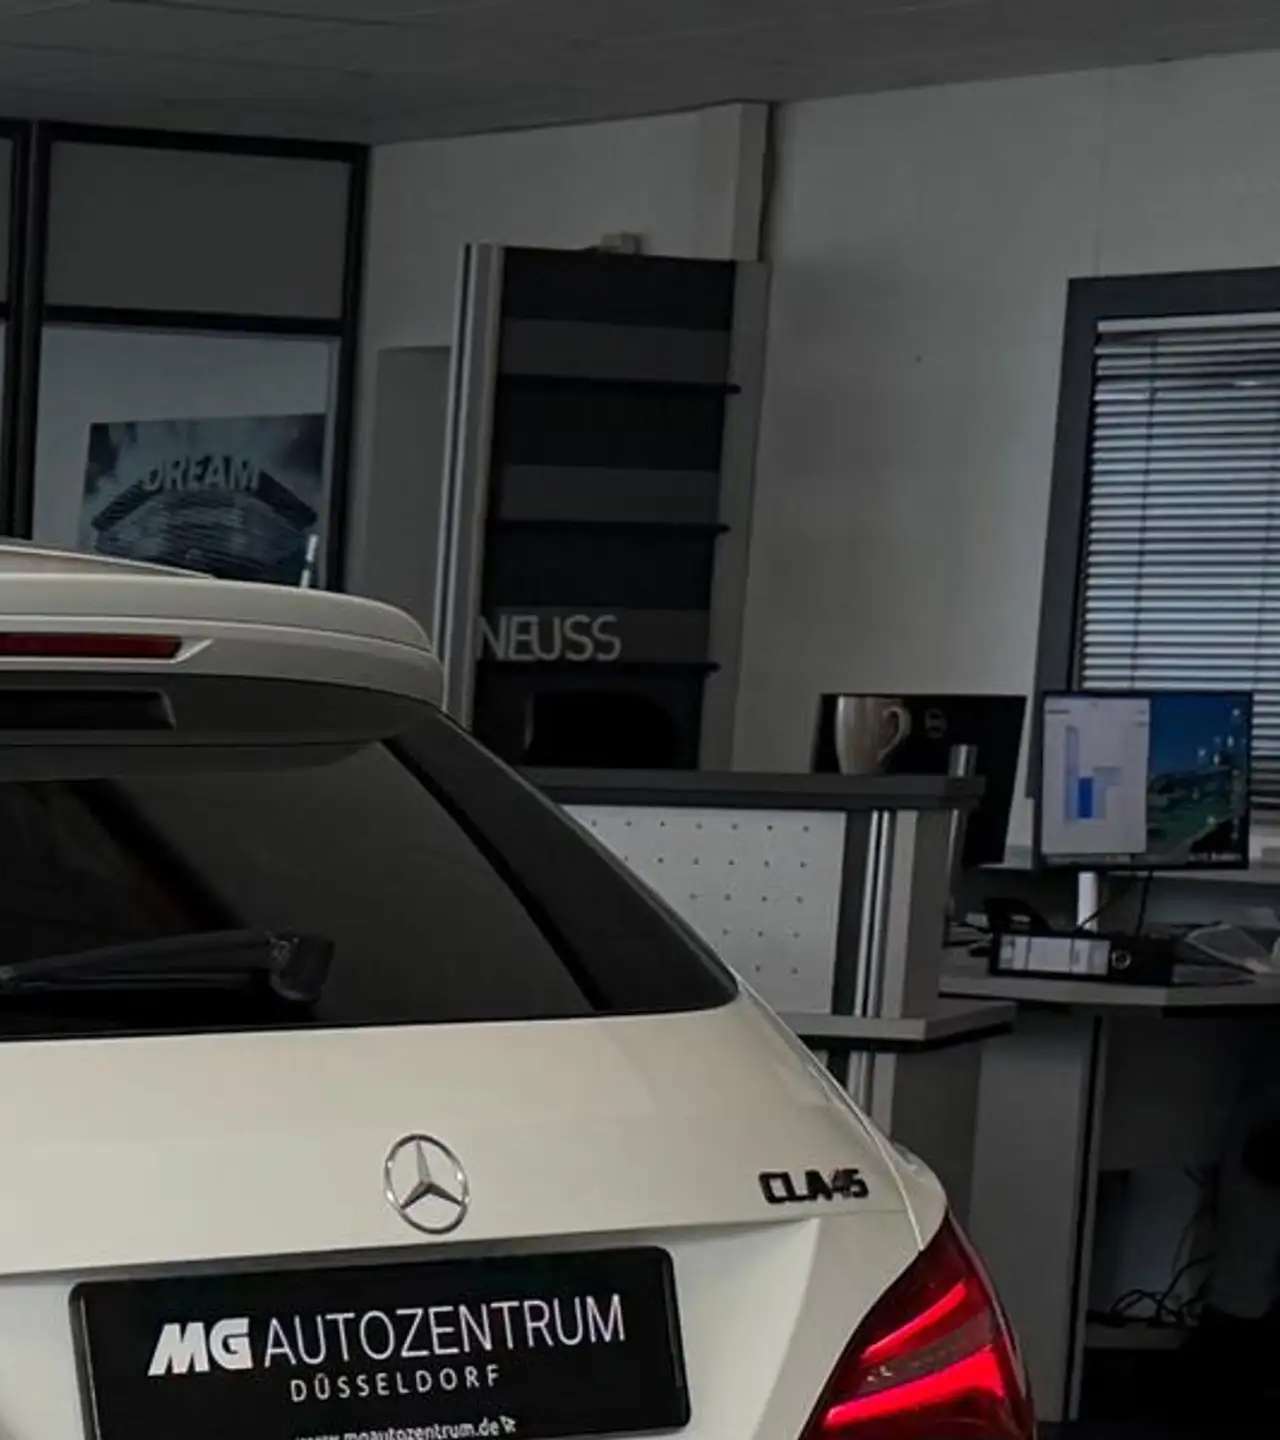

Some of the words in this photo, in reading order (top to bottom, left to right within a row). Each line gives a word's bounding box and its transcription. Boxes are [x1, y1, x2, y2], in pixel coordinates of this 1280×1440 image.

[143, 456, 261, 490] DREAM
[476, 614, 622, 662] NEUSS
[148, 1317, 253, 1377] MG
[264, 1293, 627, 1369] AUTOZENTRUM
[290, 1364, 501, 1403] DÜSSELDORF
